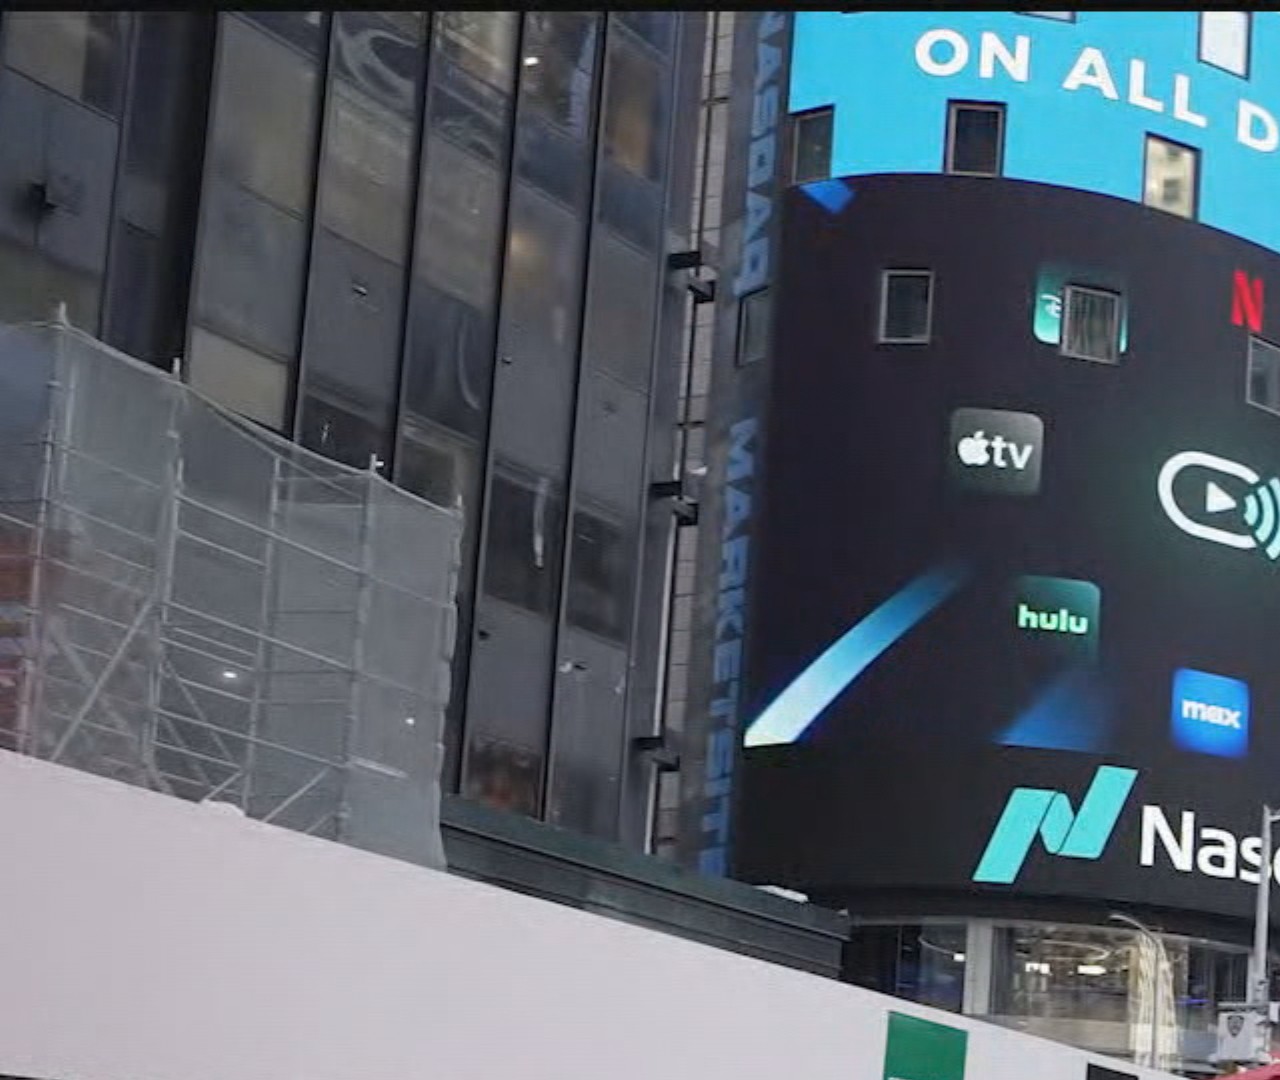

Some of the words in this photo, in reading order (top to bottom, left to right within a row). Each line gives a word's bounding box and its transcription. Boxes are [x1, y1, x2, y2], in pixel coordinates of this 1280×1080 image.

[914, 28, 1029, 83] ON
[1063, 48, 1207, 128] ALL
[992, 435, 1033, 470] tv
[1017, 605, 1089, 636] hulu
[1181, 698, 1242, 731] max
